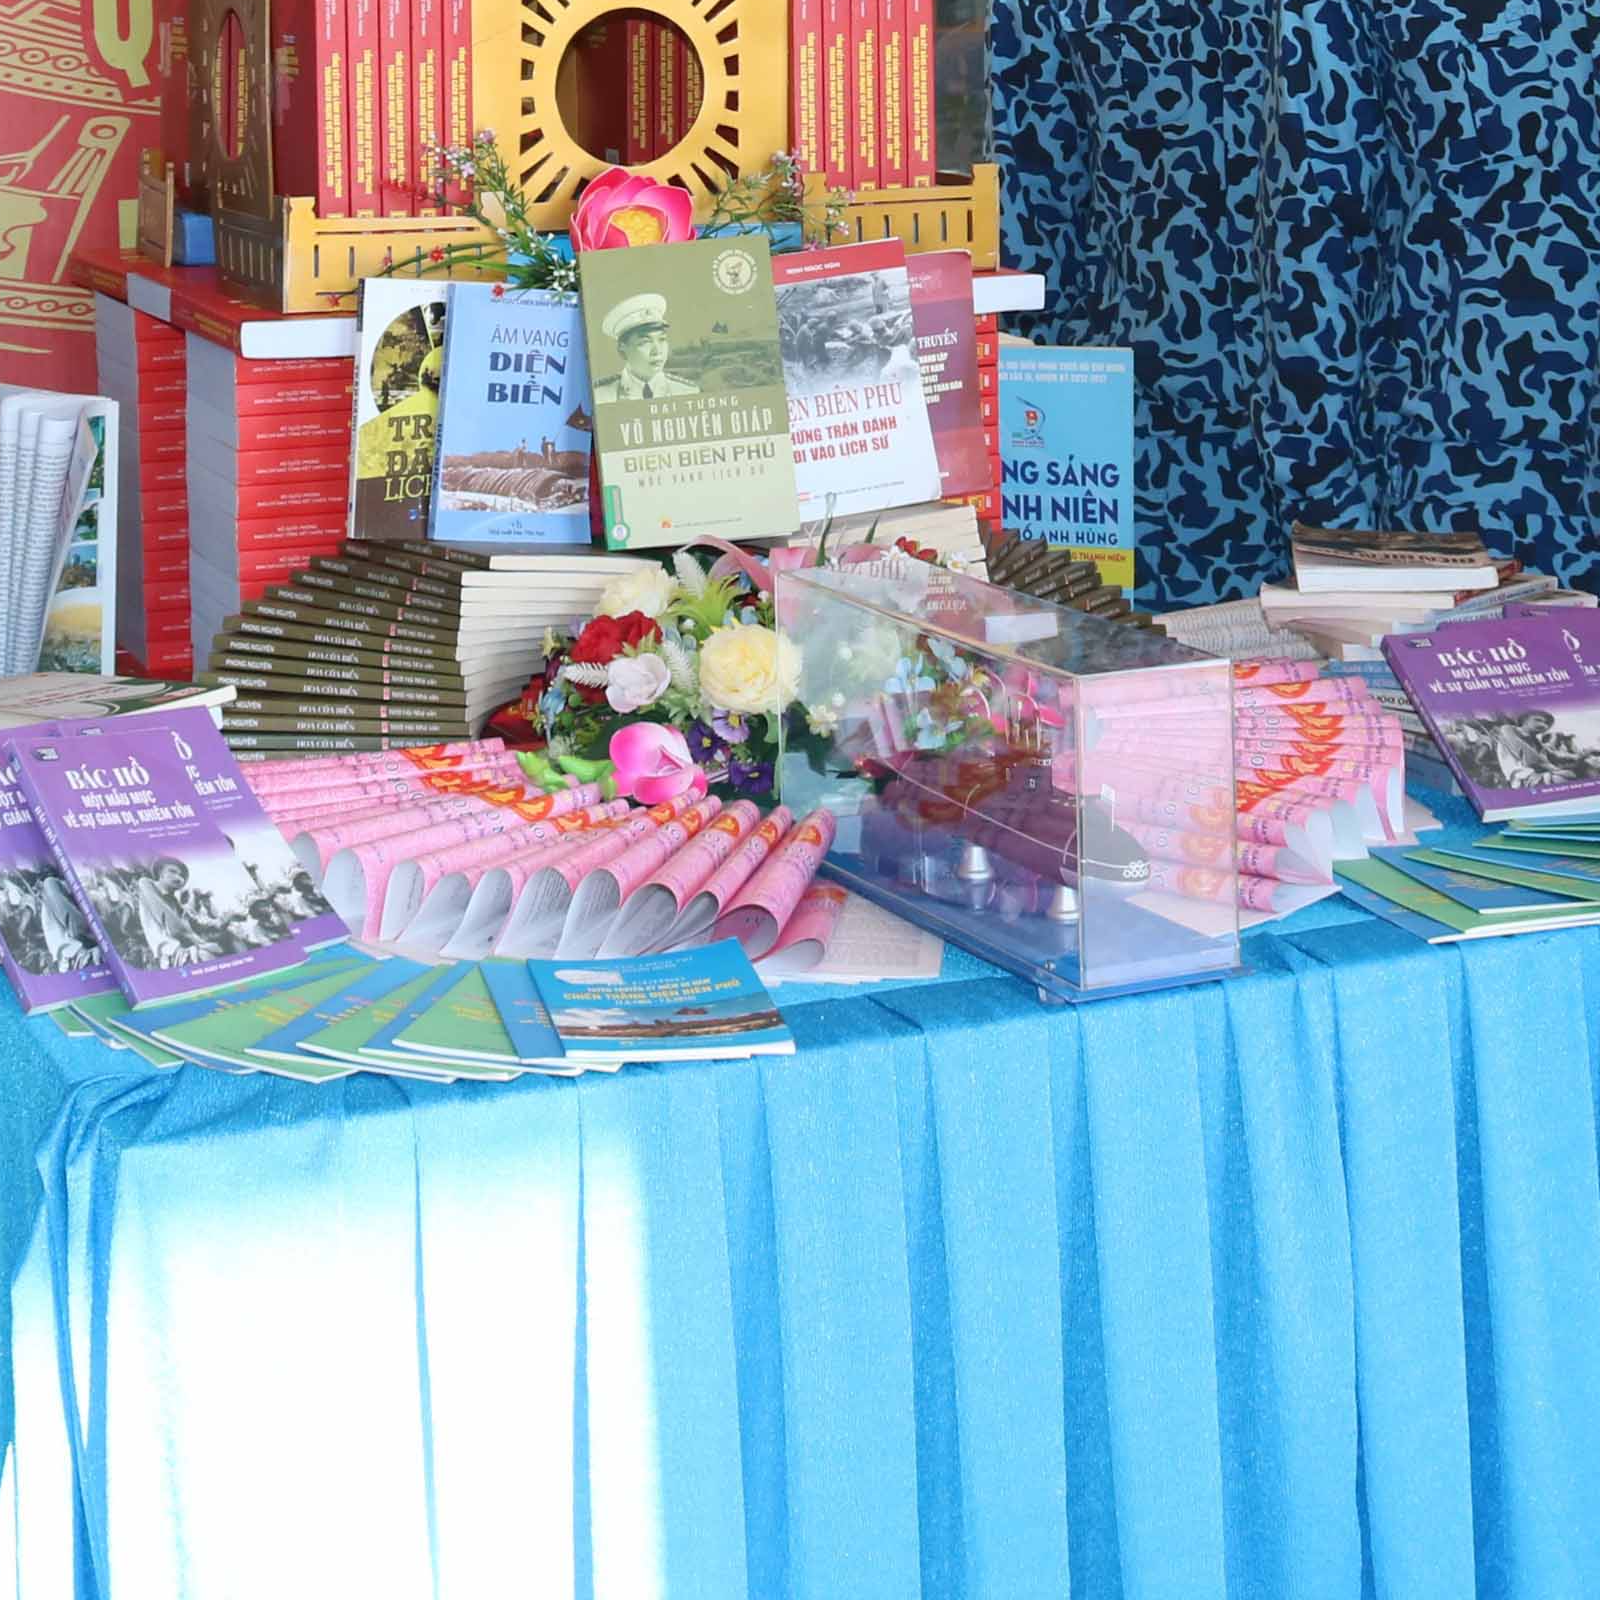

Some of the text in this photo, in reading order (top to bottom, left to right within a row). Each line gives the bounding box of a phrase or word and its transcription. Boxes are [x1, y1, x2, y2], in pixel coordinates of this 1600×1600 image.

[522, 329, 569, 348] VANG
[620, 417, 643, 446] VÕ
[731, 405, 773, 434] GIÁP
[1046, 454, 1120, 488] SÁNG
[1051, 489, 1119, 525] NIÊN
[1075, 527, 1119, 545] HÙNG
[1437, 638, 1526, 668] BÁC HỒ
[1450, 667, 1477, 680] MỘT
[64, 756, 150, 790] BÁC HỒ
